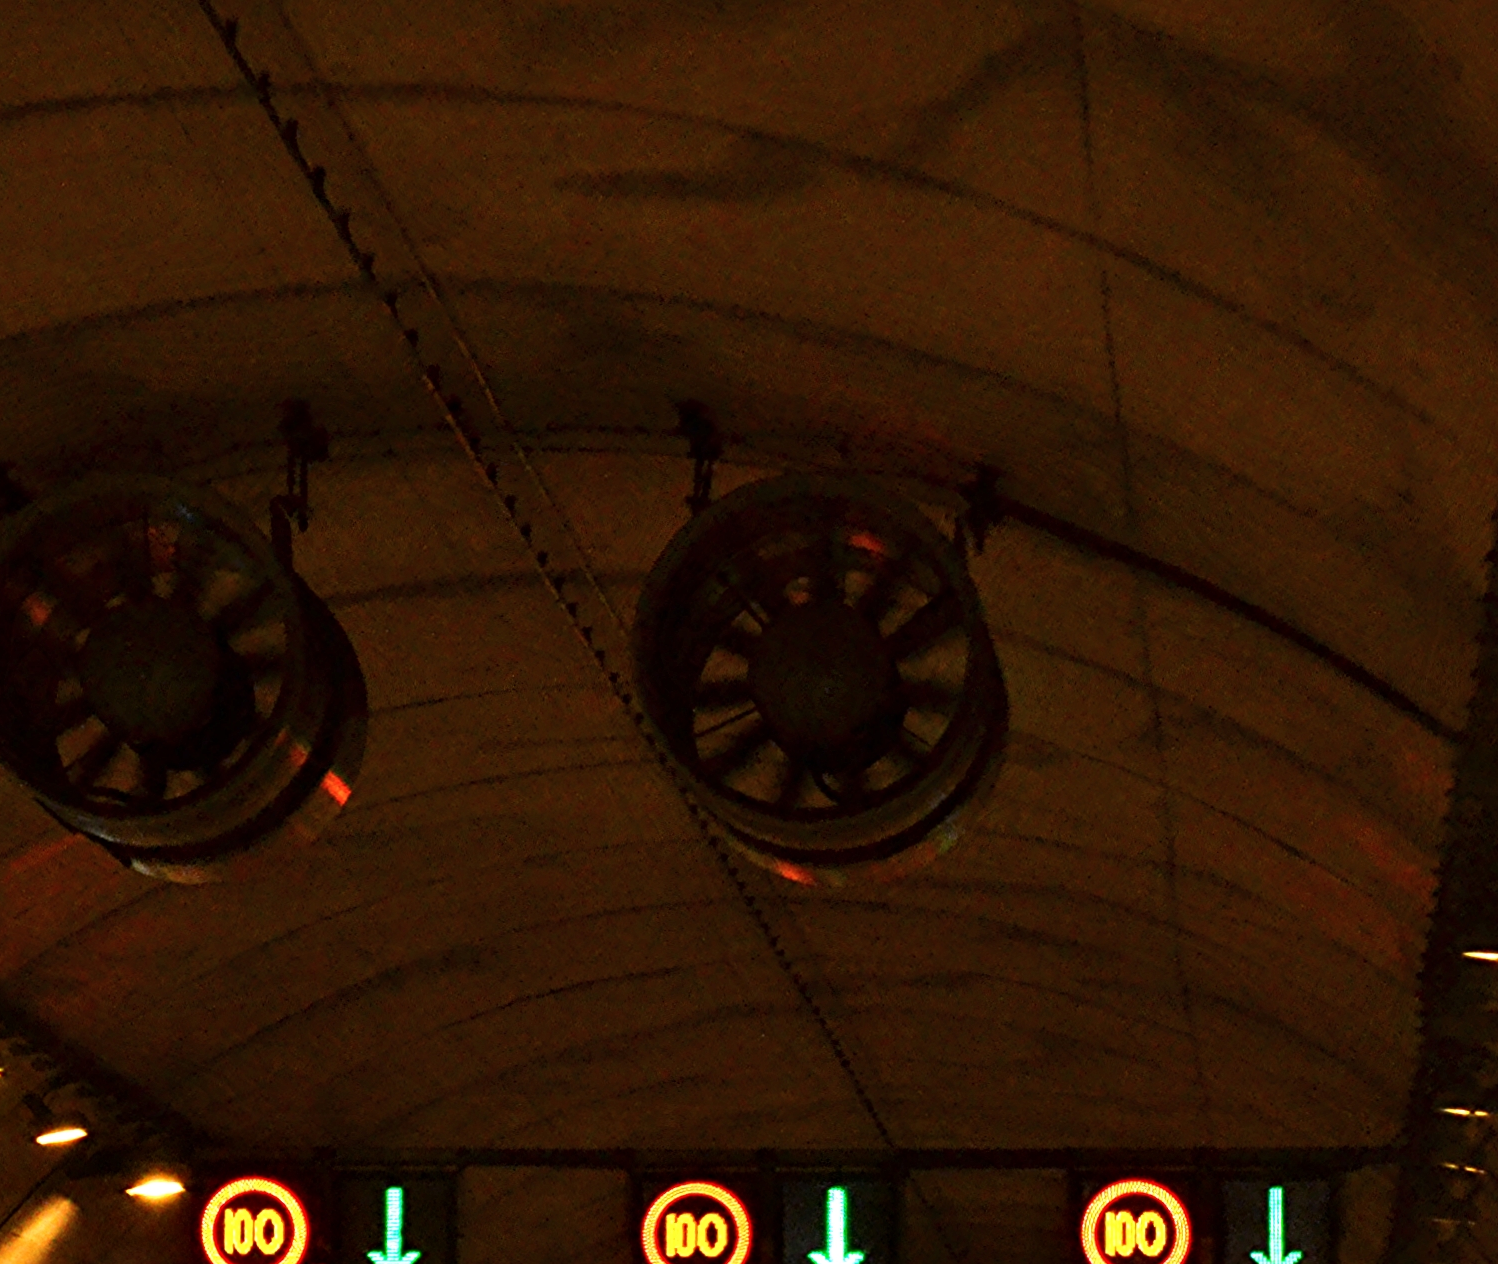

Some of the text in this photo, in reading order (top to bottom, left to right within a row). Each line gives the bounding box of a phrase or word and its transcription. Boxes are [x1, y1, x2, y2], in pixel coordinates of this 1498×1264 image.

[224, 1208, 284, 1255] 100
[665, 1212, 728, 1258] 100
[1104, 1210, 1167, 1257] 100
